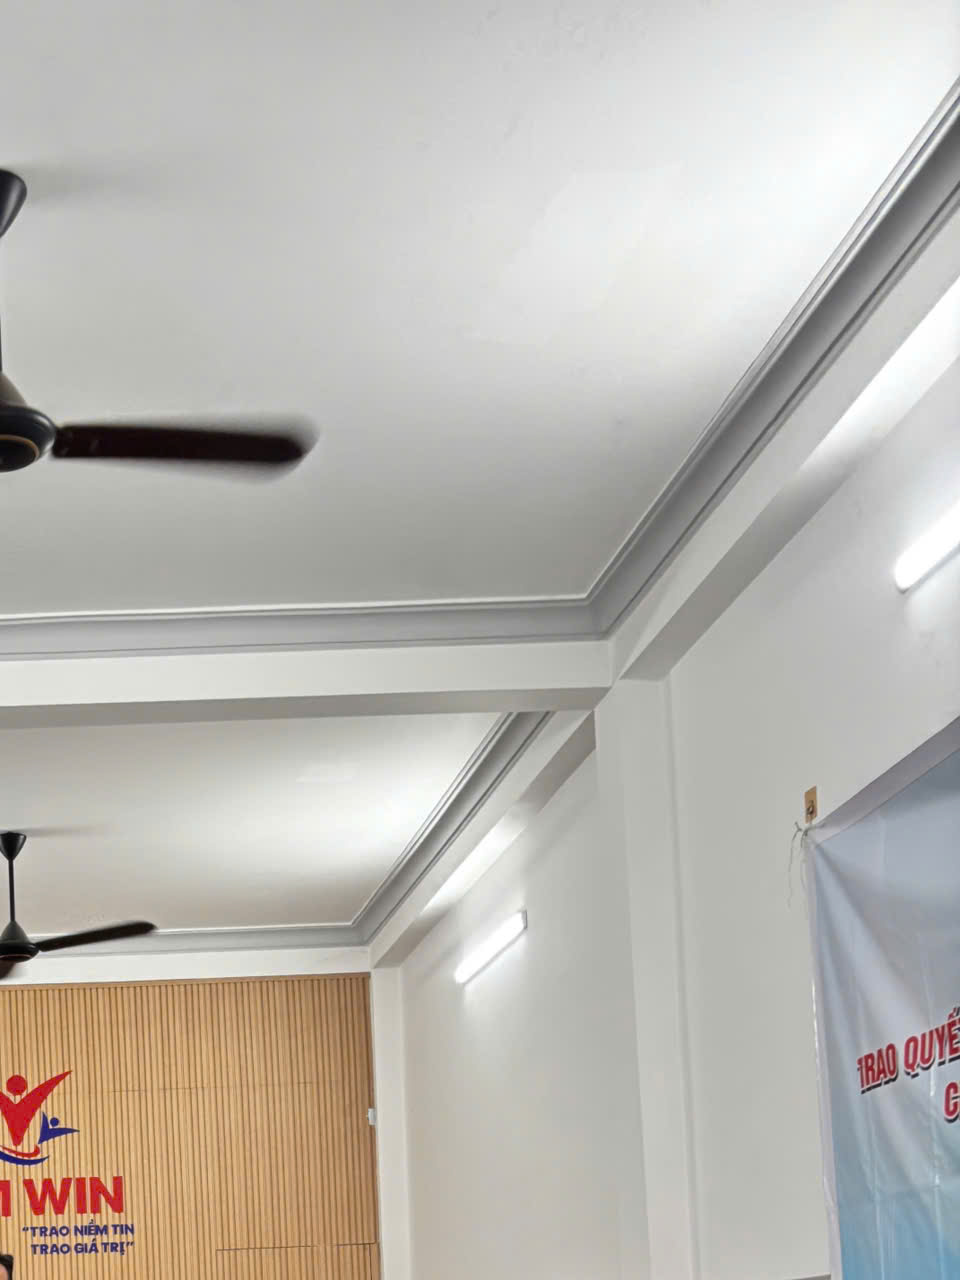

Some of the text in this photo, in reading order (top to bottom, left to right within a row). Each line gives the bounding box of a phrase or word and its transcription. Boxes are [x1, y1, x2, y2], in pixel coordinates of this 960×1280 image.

[904, 1007, 960, 1074] QUYẾ
[23, 1176, 124, 1216] WIN
[111, 1224, 135, 1236] TIN
[31, 1243, 71, 1255] TRAO
[74, 1238, 99, 1254] GIÁ
